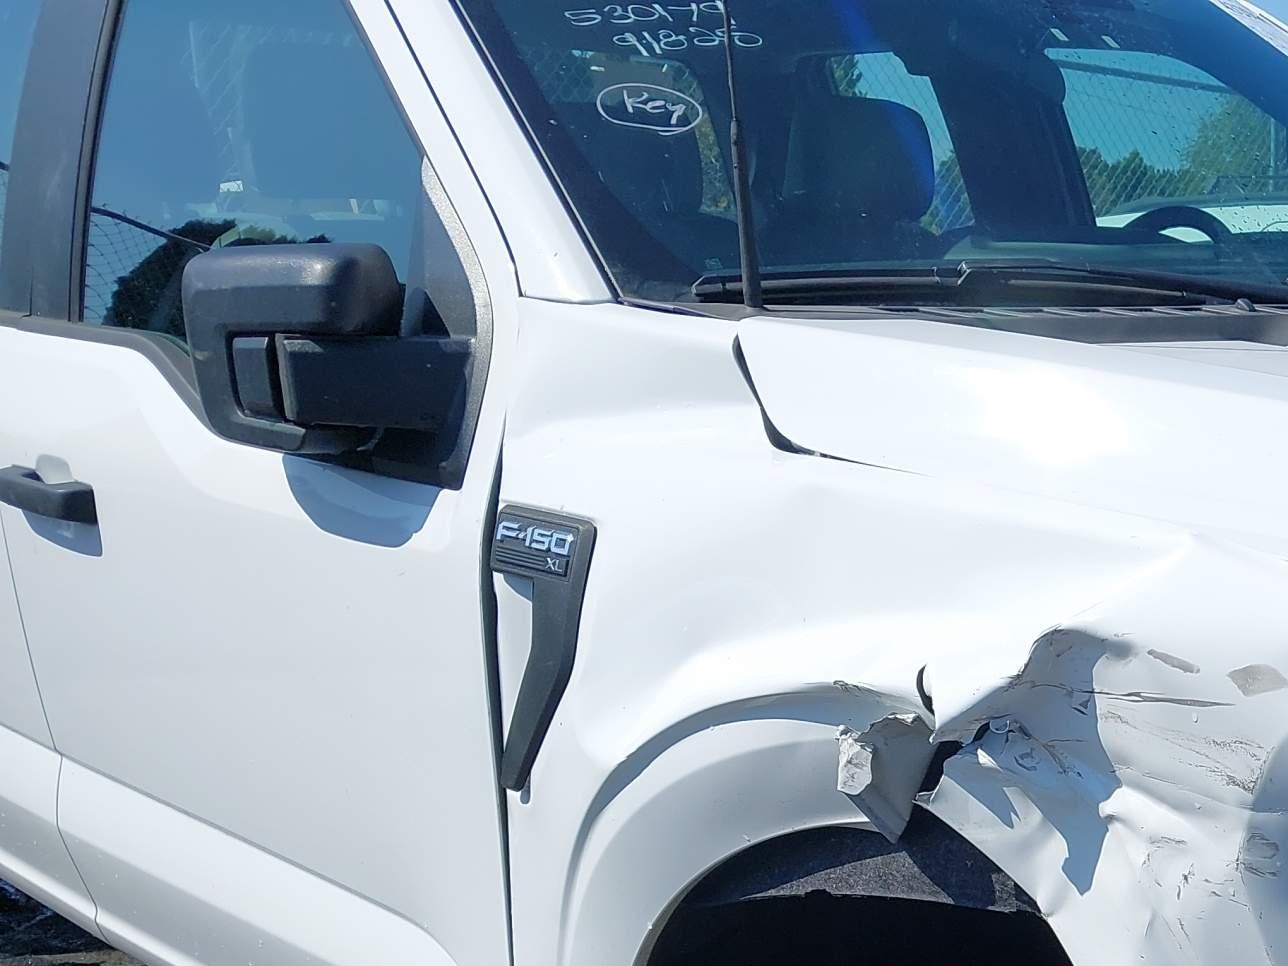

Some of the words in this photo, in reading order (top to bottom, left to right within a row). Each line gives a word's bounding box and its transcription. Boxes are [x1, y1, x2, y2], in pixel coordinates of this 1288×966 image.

[623, 89, 687, 125] Key
[496, 521, 575, 556] F-150
[545, 557, 563, 572] XL
